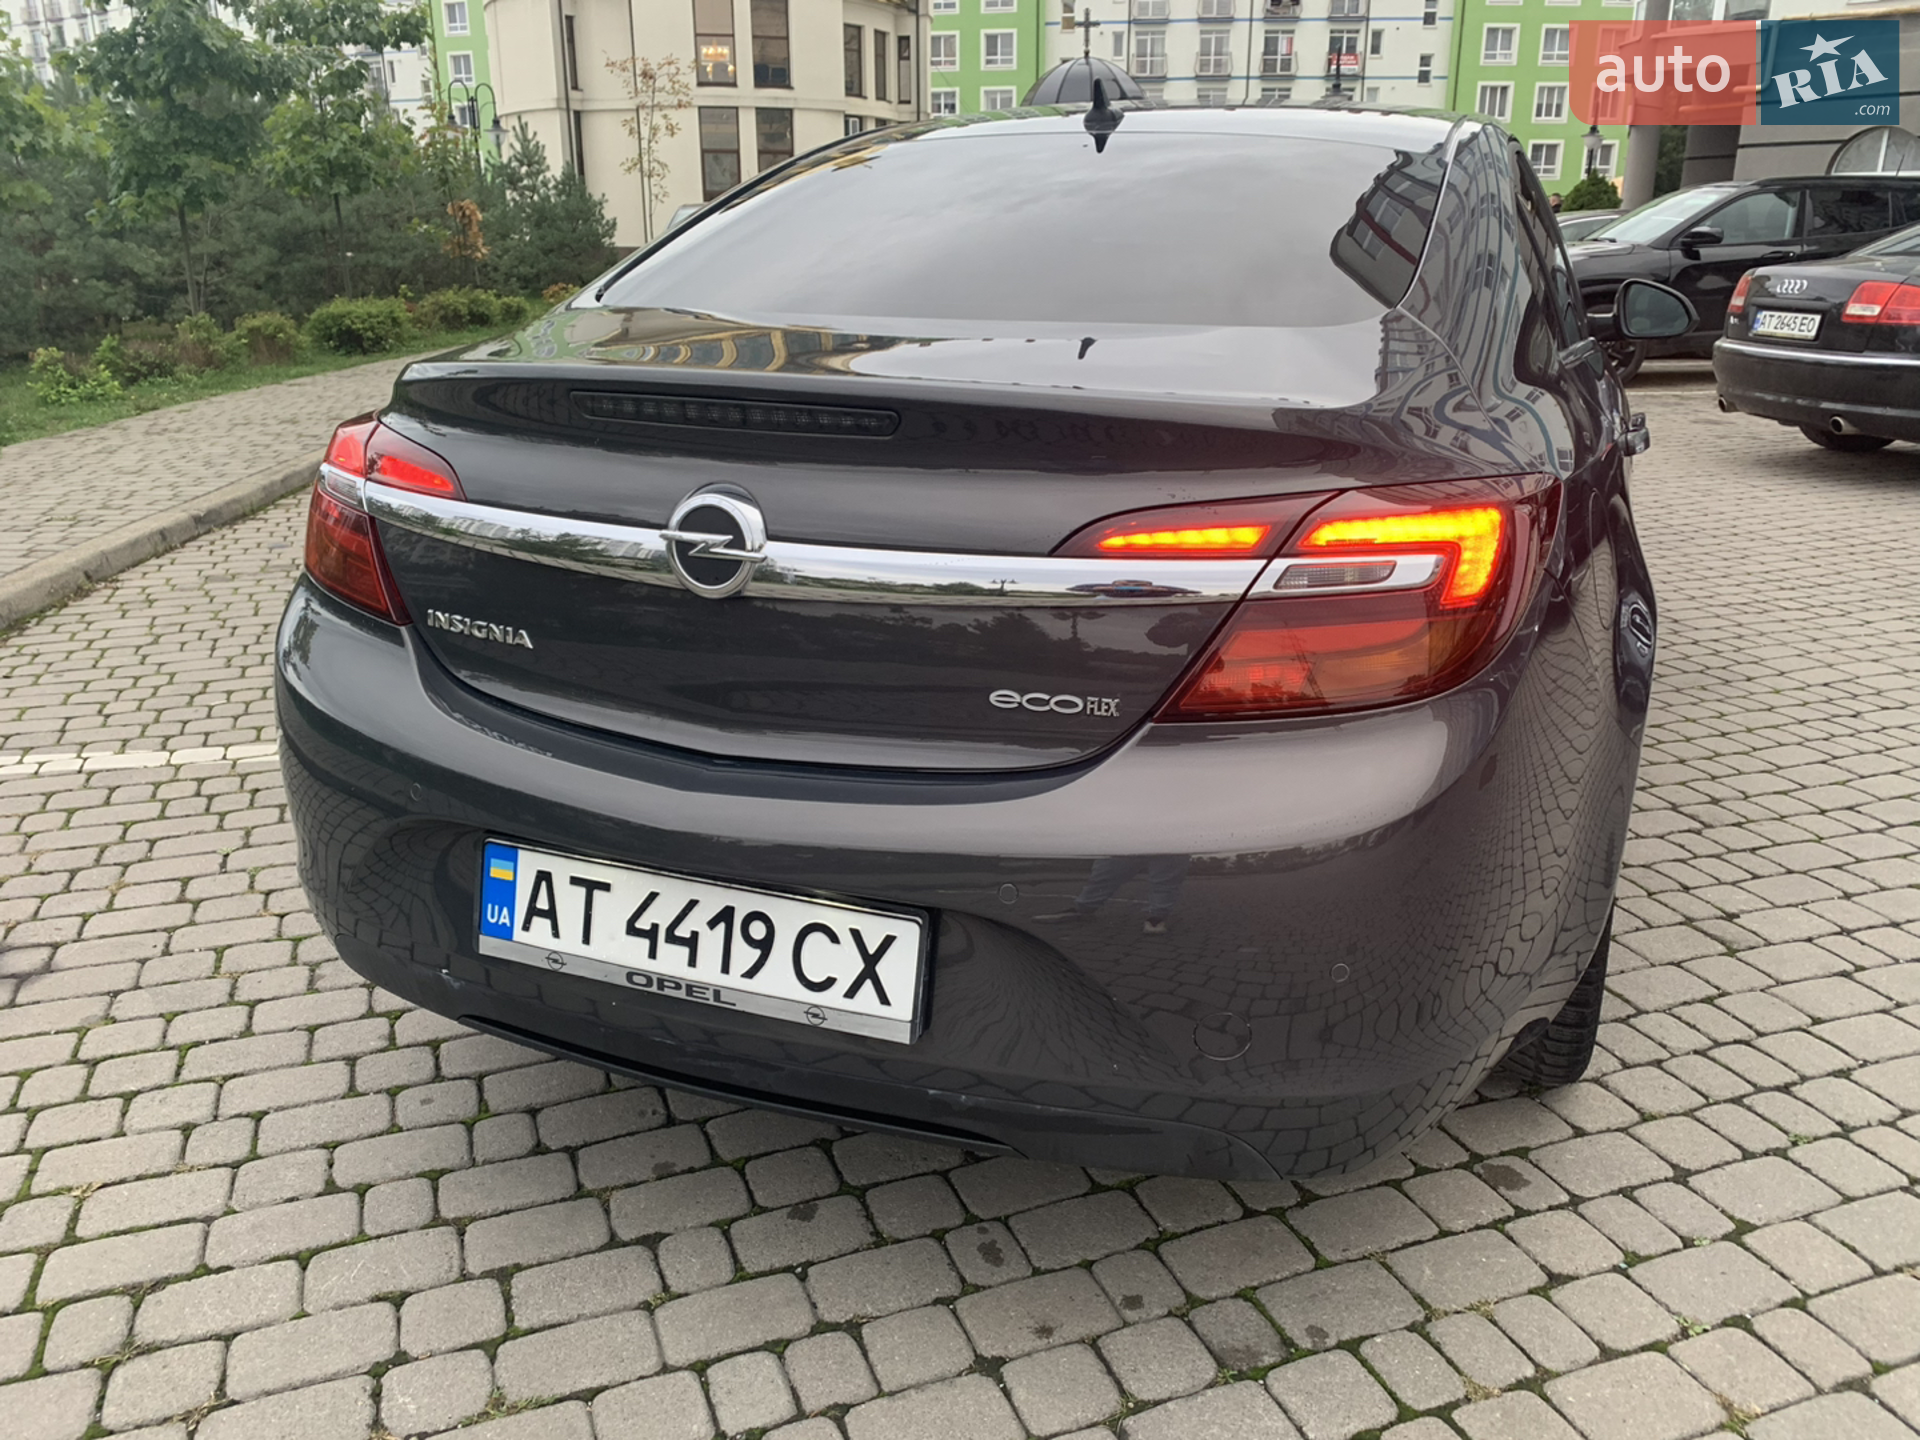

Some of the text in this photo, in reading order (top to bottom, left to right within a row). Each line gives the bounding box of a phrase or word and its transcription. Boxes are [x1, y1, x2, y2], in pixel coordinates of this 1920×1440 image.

[1759, 314, 1776, 330] AT
[1773, 315, 1799, 331] 2645
[1798, 316, 1817, 333] EO
[427, 608, 534, 649] INSIGNIA
[486, 902, 511, 928] UA
[520, 869, 898, 1006] AT 4419 CX
[625, 970, 737, 1006] OPEL
